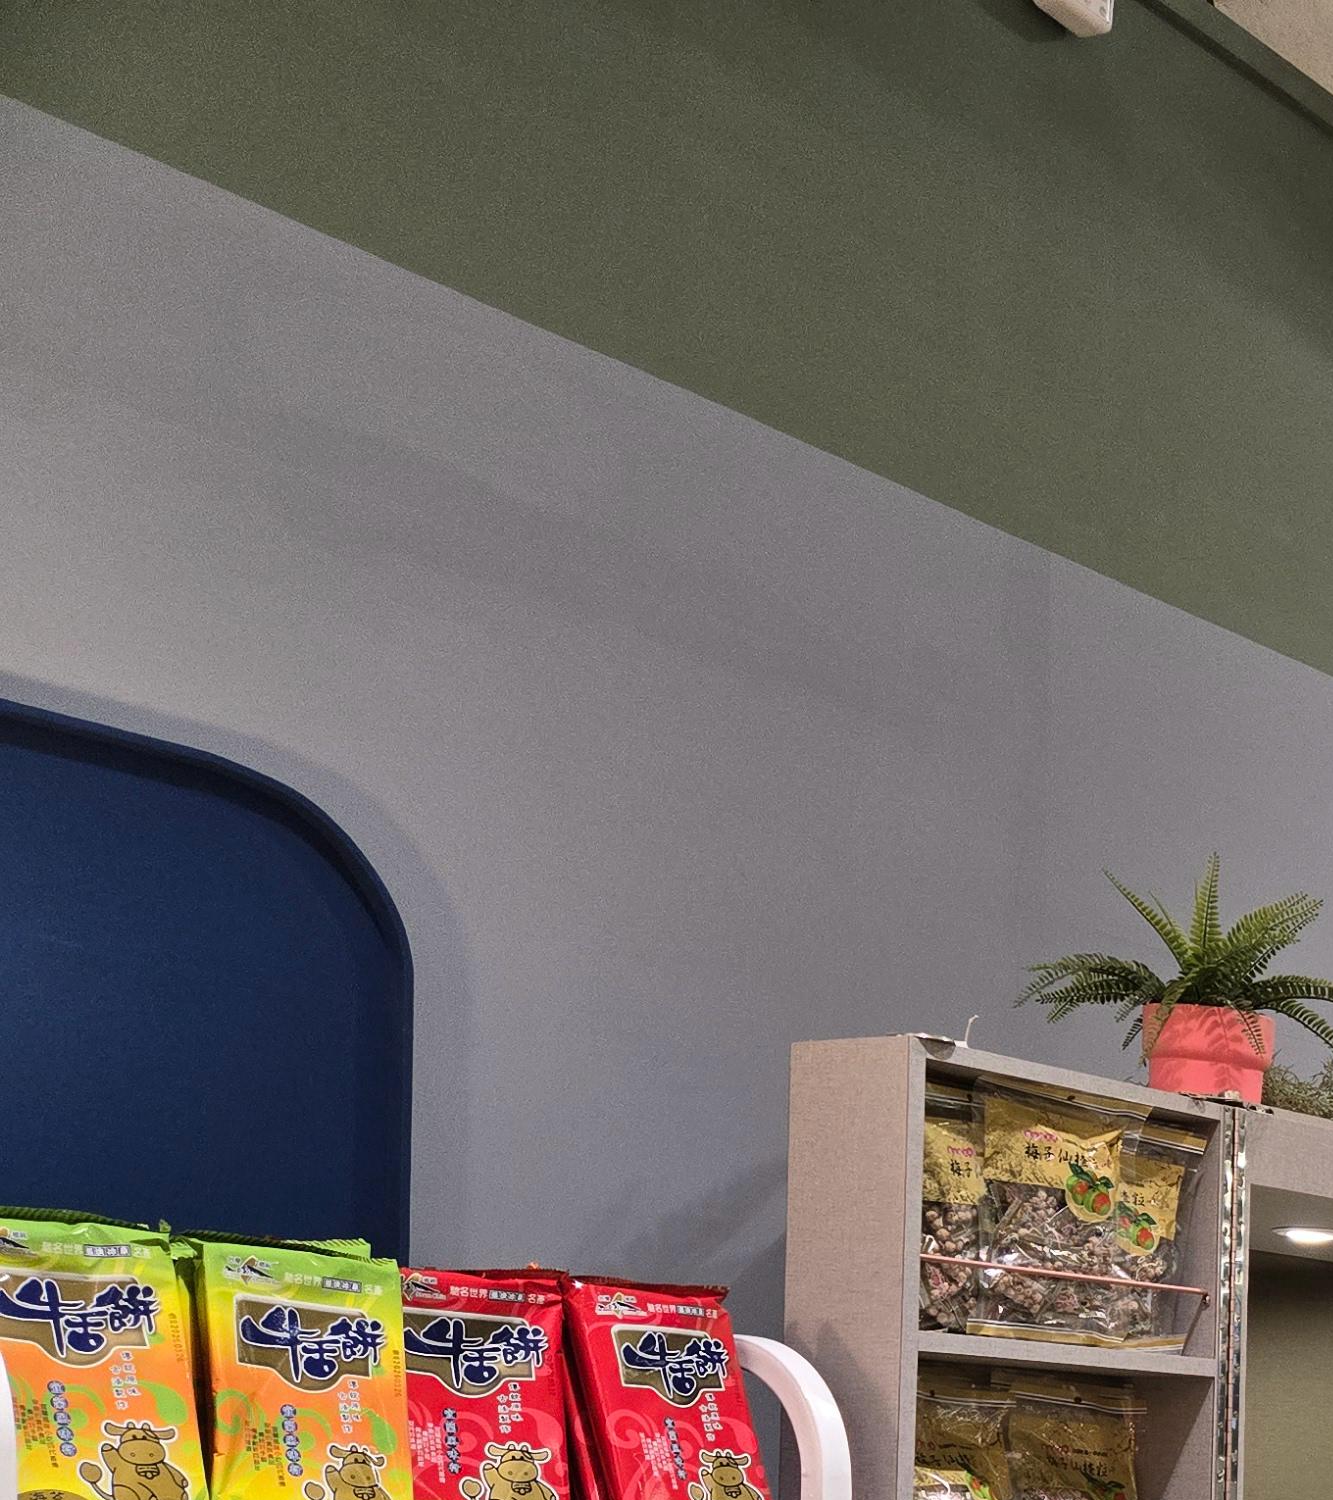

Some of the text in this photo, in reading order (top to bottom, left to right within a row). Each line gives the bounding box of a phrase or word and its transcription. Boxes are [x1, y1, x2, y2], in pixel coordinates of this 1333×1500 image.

[0, 1276, 160, 1358] 牛舌餅
[239, 1305, 385, 1382] 牛舌餅
[404, 1317, 548, 1388] 牛舌餅
[622, 1331, 727, 1399] 牛舌餅
